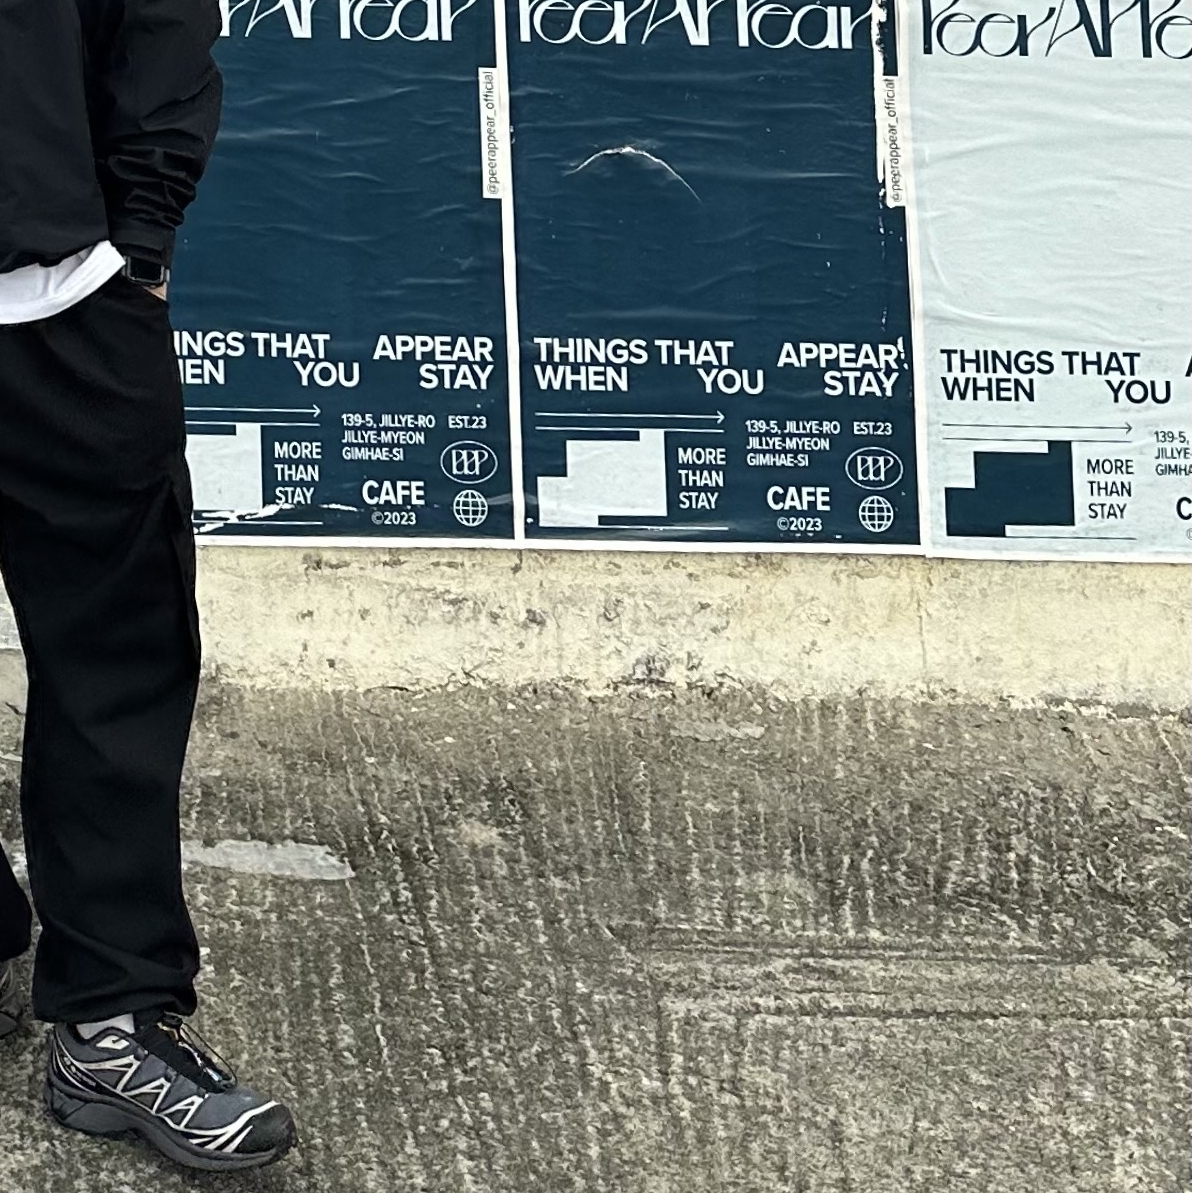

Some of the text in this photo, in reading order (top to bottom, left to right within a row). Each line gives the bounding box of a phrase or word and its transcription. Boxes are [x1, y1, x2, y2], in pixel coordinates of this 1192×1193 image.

[482, 71, 498, 195] @peerappear_official
[251, 332, 330, 358] THAT
[373, 335, 493, 361] APPEAR
[534, 338, 899, 369] THINGS THAT APPEAR
[940, 349, 1140, 376] THINGS THAT
[294, 361, 359, 387] YOU
[420, 364, 493, 389] STAY
[534, 365, 899, 397] WHEN YOU STAY
[941, 377, 1170, 404] WHEN YOU
[342, 414, 435, 428] 139-5, JILLYE-RO
[448, 416, 486, 429] EST.23
[746, 420, 840, 434] 139-5, JILLYE-RO
[854, 422, 892, 435] EST.23
[342, 430, 424, 444] JILLYE-MYEON
[747, 437, 829, 450] JILLYE-MYEON
[1154, 431, 1189, 444] 139-5,
[275, 442, 321, 458] MORE
[342, 447, 403, 460] GIMHAE-SI
[678, 448, 726, 464] MORE
[1155, 447, 1192, 459] JILLYE
[747, 453, 808, 466] GIMHAE-SI
[1087, 459, 1134, 474] MORE
[274, 464, 319, 481] THAN
[678, 470, 723, 486] THAN
[275, 487, 314, 506] STAY
[363, 480, 424, 505] CAFE
[1088, 481, 1131, 497] THAN
[679, 492, 718, 509] STAY
[767, 486, 830, 510] CAFE
[1088, 503, 1126, 519] STAY
